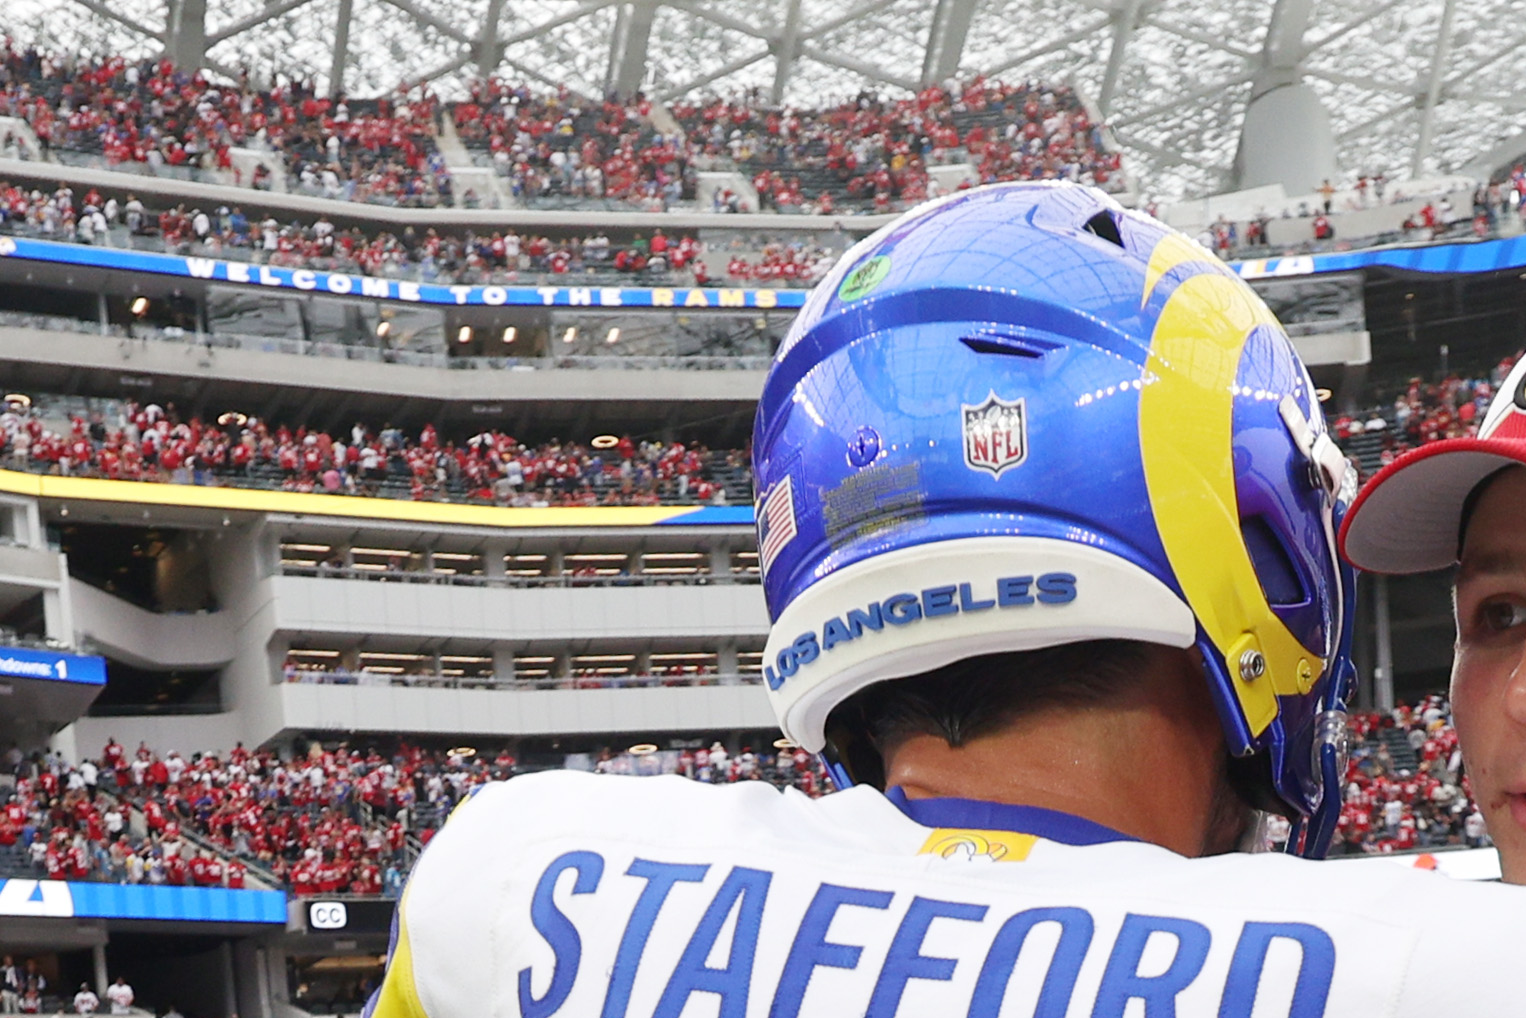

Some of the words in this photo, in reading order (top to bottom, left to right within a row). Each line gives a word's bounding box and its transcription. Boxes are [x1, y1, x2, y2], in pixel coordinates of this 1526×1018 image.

[186, 256, 422, 301] WELCOME
[449, 285, 508, 305] TO
[537, 287, 622, 306] THE
[652, 287, 778, 308] RAMS
[1239, 255, 1315, 279] LA
[972, 429, 1019, 465] NFL
[764, 631, 821, 692] LOS
[822, 571, 1078, 651] ANGELES
[54, 659, 68, 680] 1
[0, 878, 75, 918] A
[316, 907, 341, 924] CC
